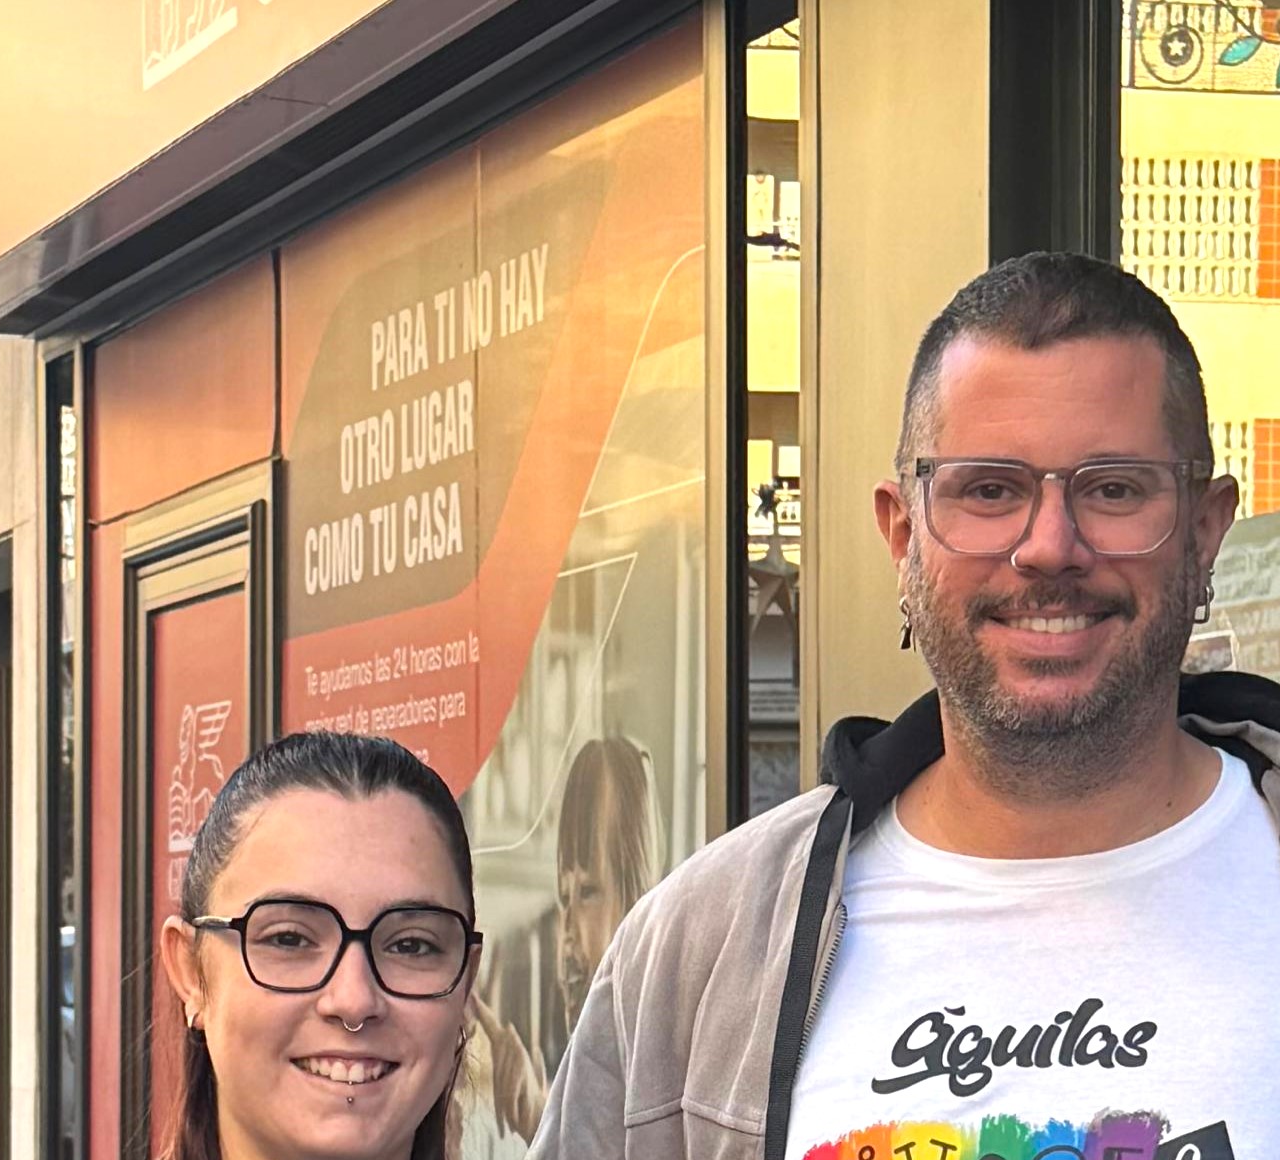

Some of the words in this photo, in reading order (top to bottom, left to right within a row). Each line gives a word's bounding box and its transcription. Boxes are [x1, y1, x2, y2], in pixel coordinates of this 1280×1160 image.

[372, 302, 428, 391] PARA
[434, 288, 455, 364] TI
[463, 270, 493, 354] NO
[500, 243, 548, 338] HAY
[341, 409, 394, 494] OTRO
[401, 379, 474, 474] LUGAR
[304, 512, 364, 595] COMO
[370, 502, 397, 576] TU
[403, 482, 463, 568] CASA
[305, 666, 317, 696] Te
[320, 660, 372, 701] ayudamos
[375, 653, 391, 683] las
[393, 646, 408, 679] 24
[410, 644, 442, 674] horas
[445, 639, 466, 668] con
[469, 629, 479, 663] la
[355, 703, 369, 734] de
[439, 691, 466, 728] para
